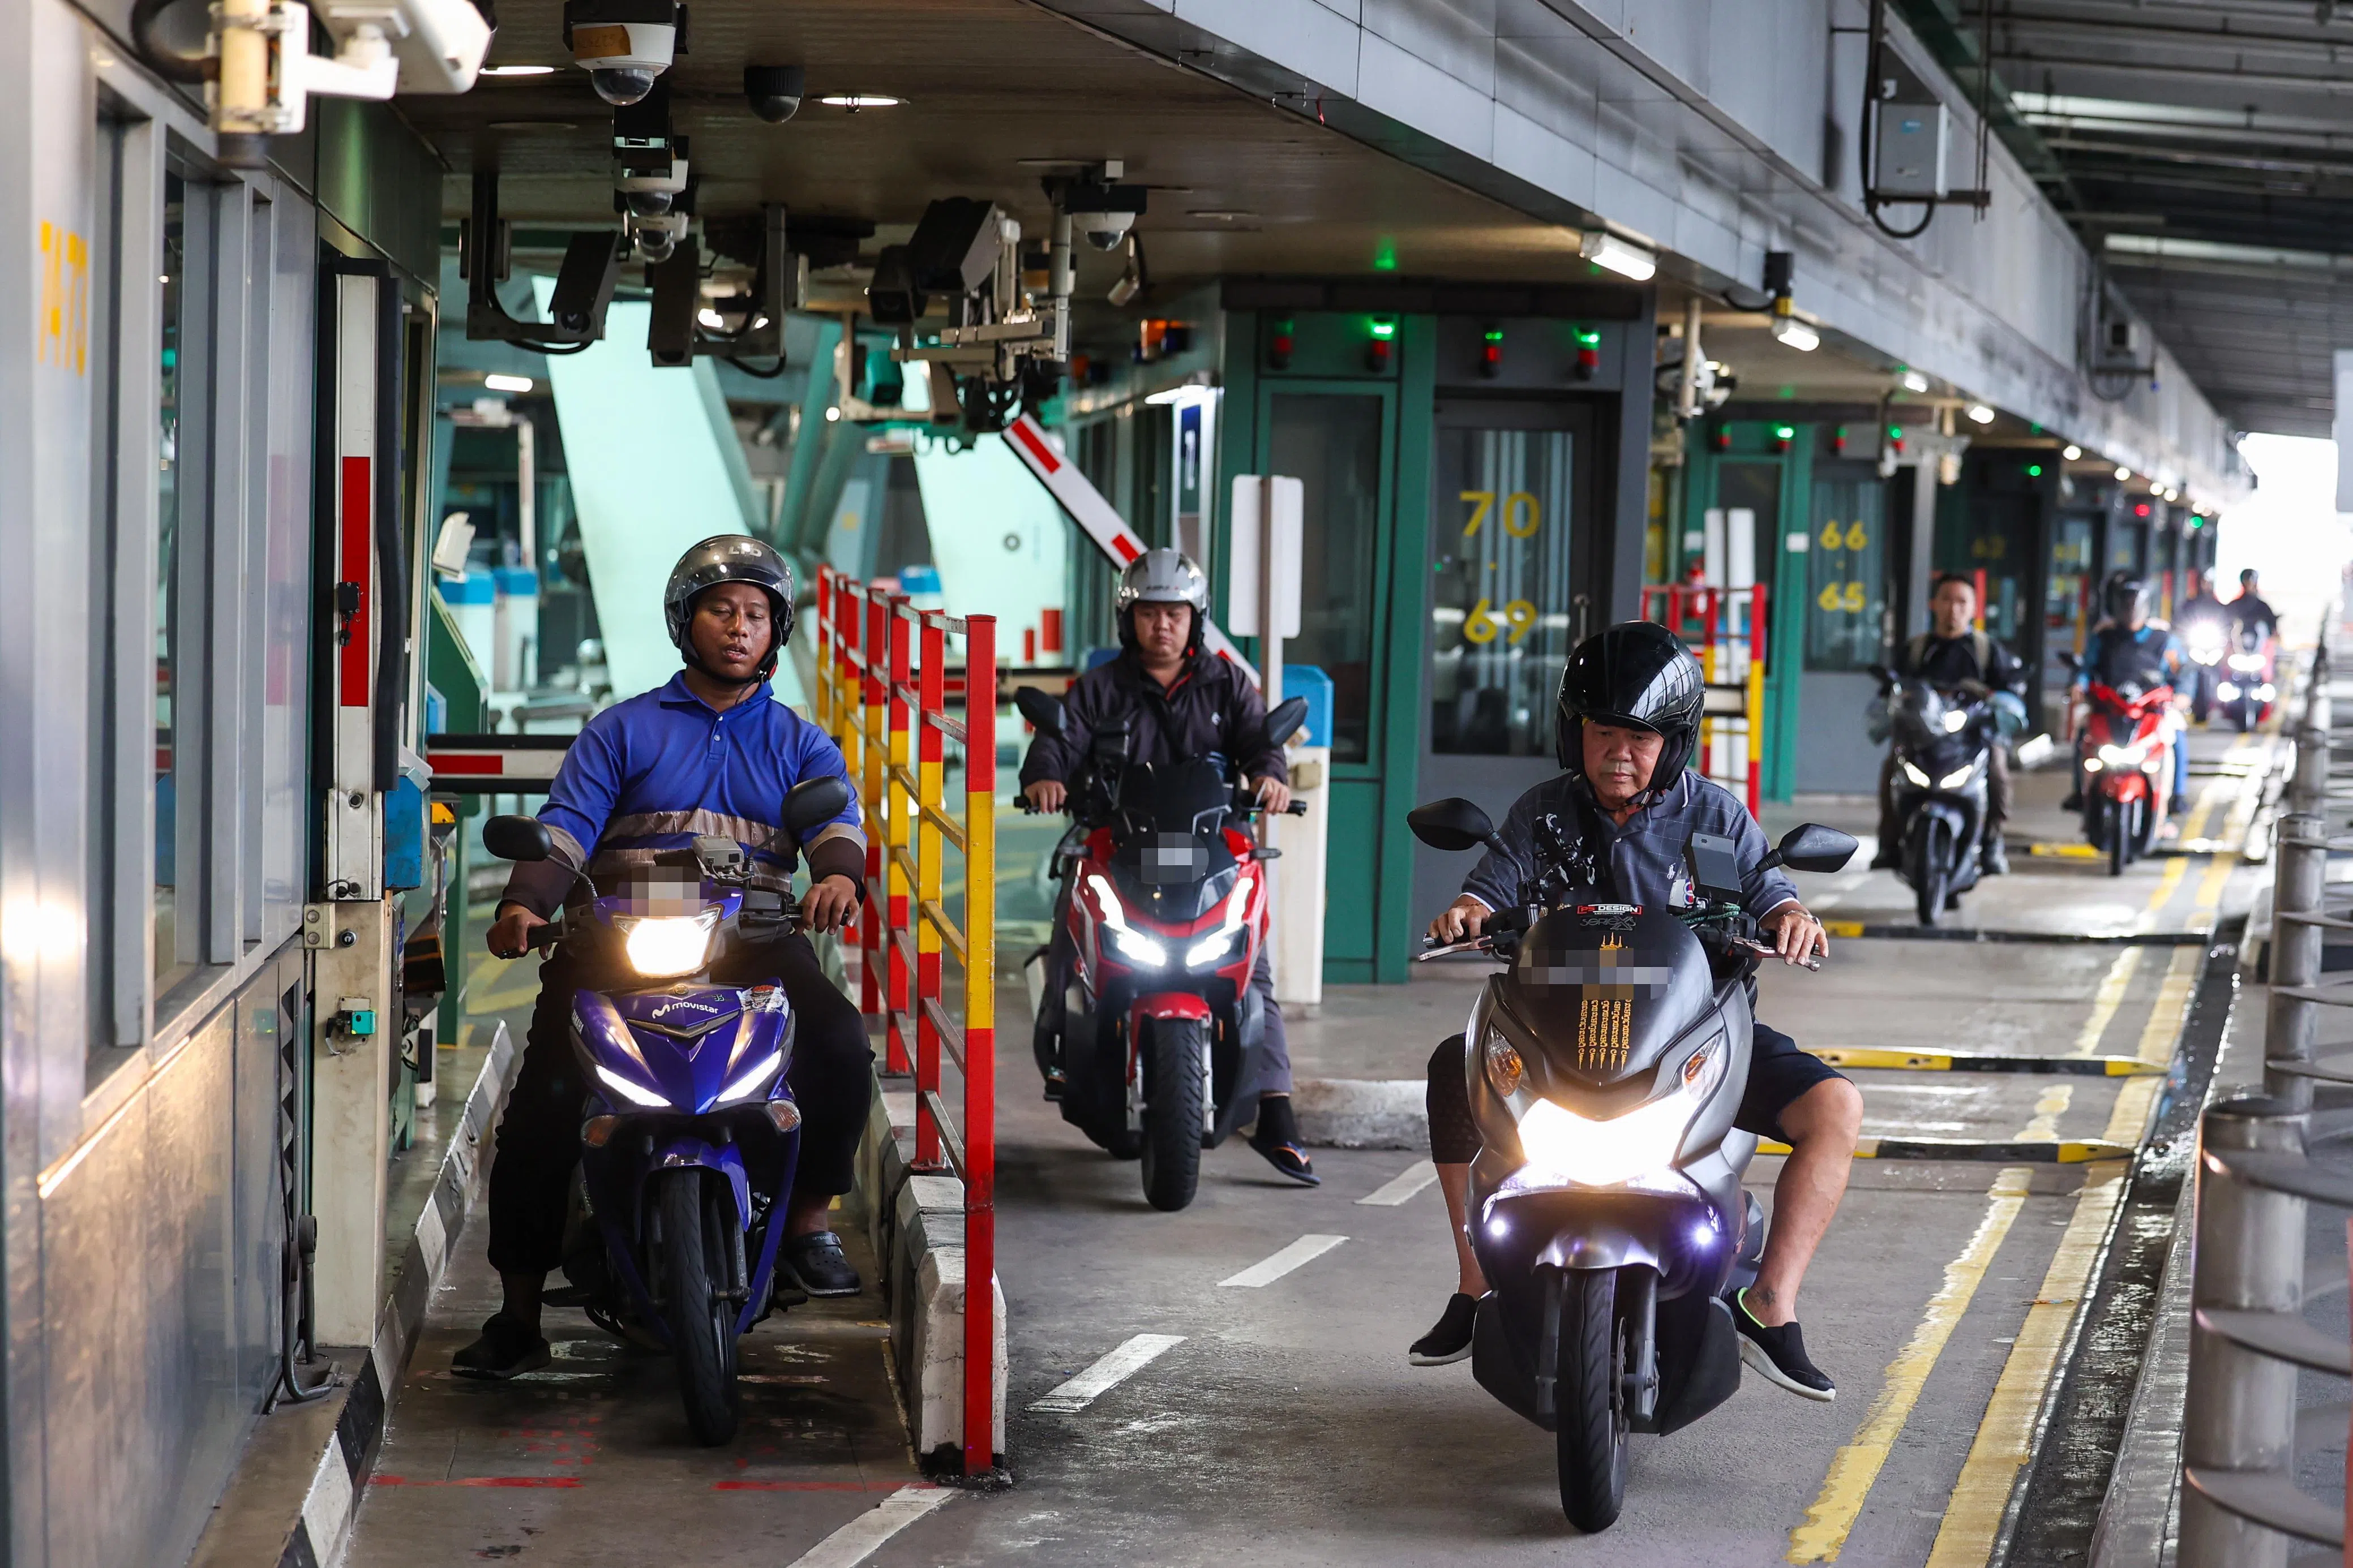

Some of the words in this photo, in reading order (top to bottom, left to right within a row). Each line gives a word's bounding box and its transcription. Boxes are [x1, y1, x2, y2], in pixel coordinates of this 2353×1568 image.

[1459, 491, 1541, 538] 70
[1819, 519, 1868, 551] 66
[1817, 581, 1866, 613] 65
[1463, 596, 1537, 644] 69
[672, 1002, 718, 1014] movistar
